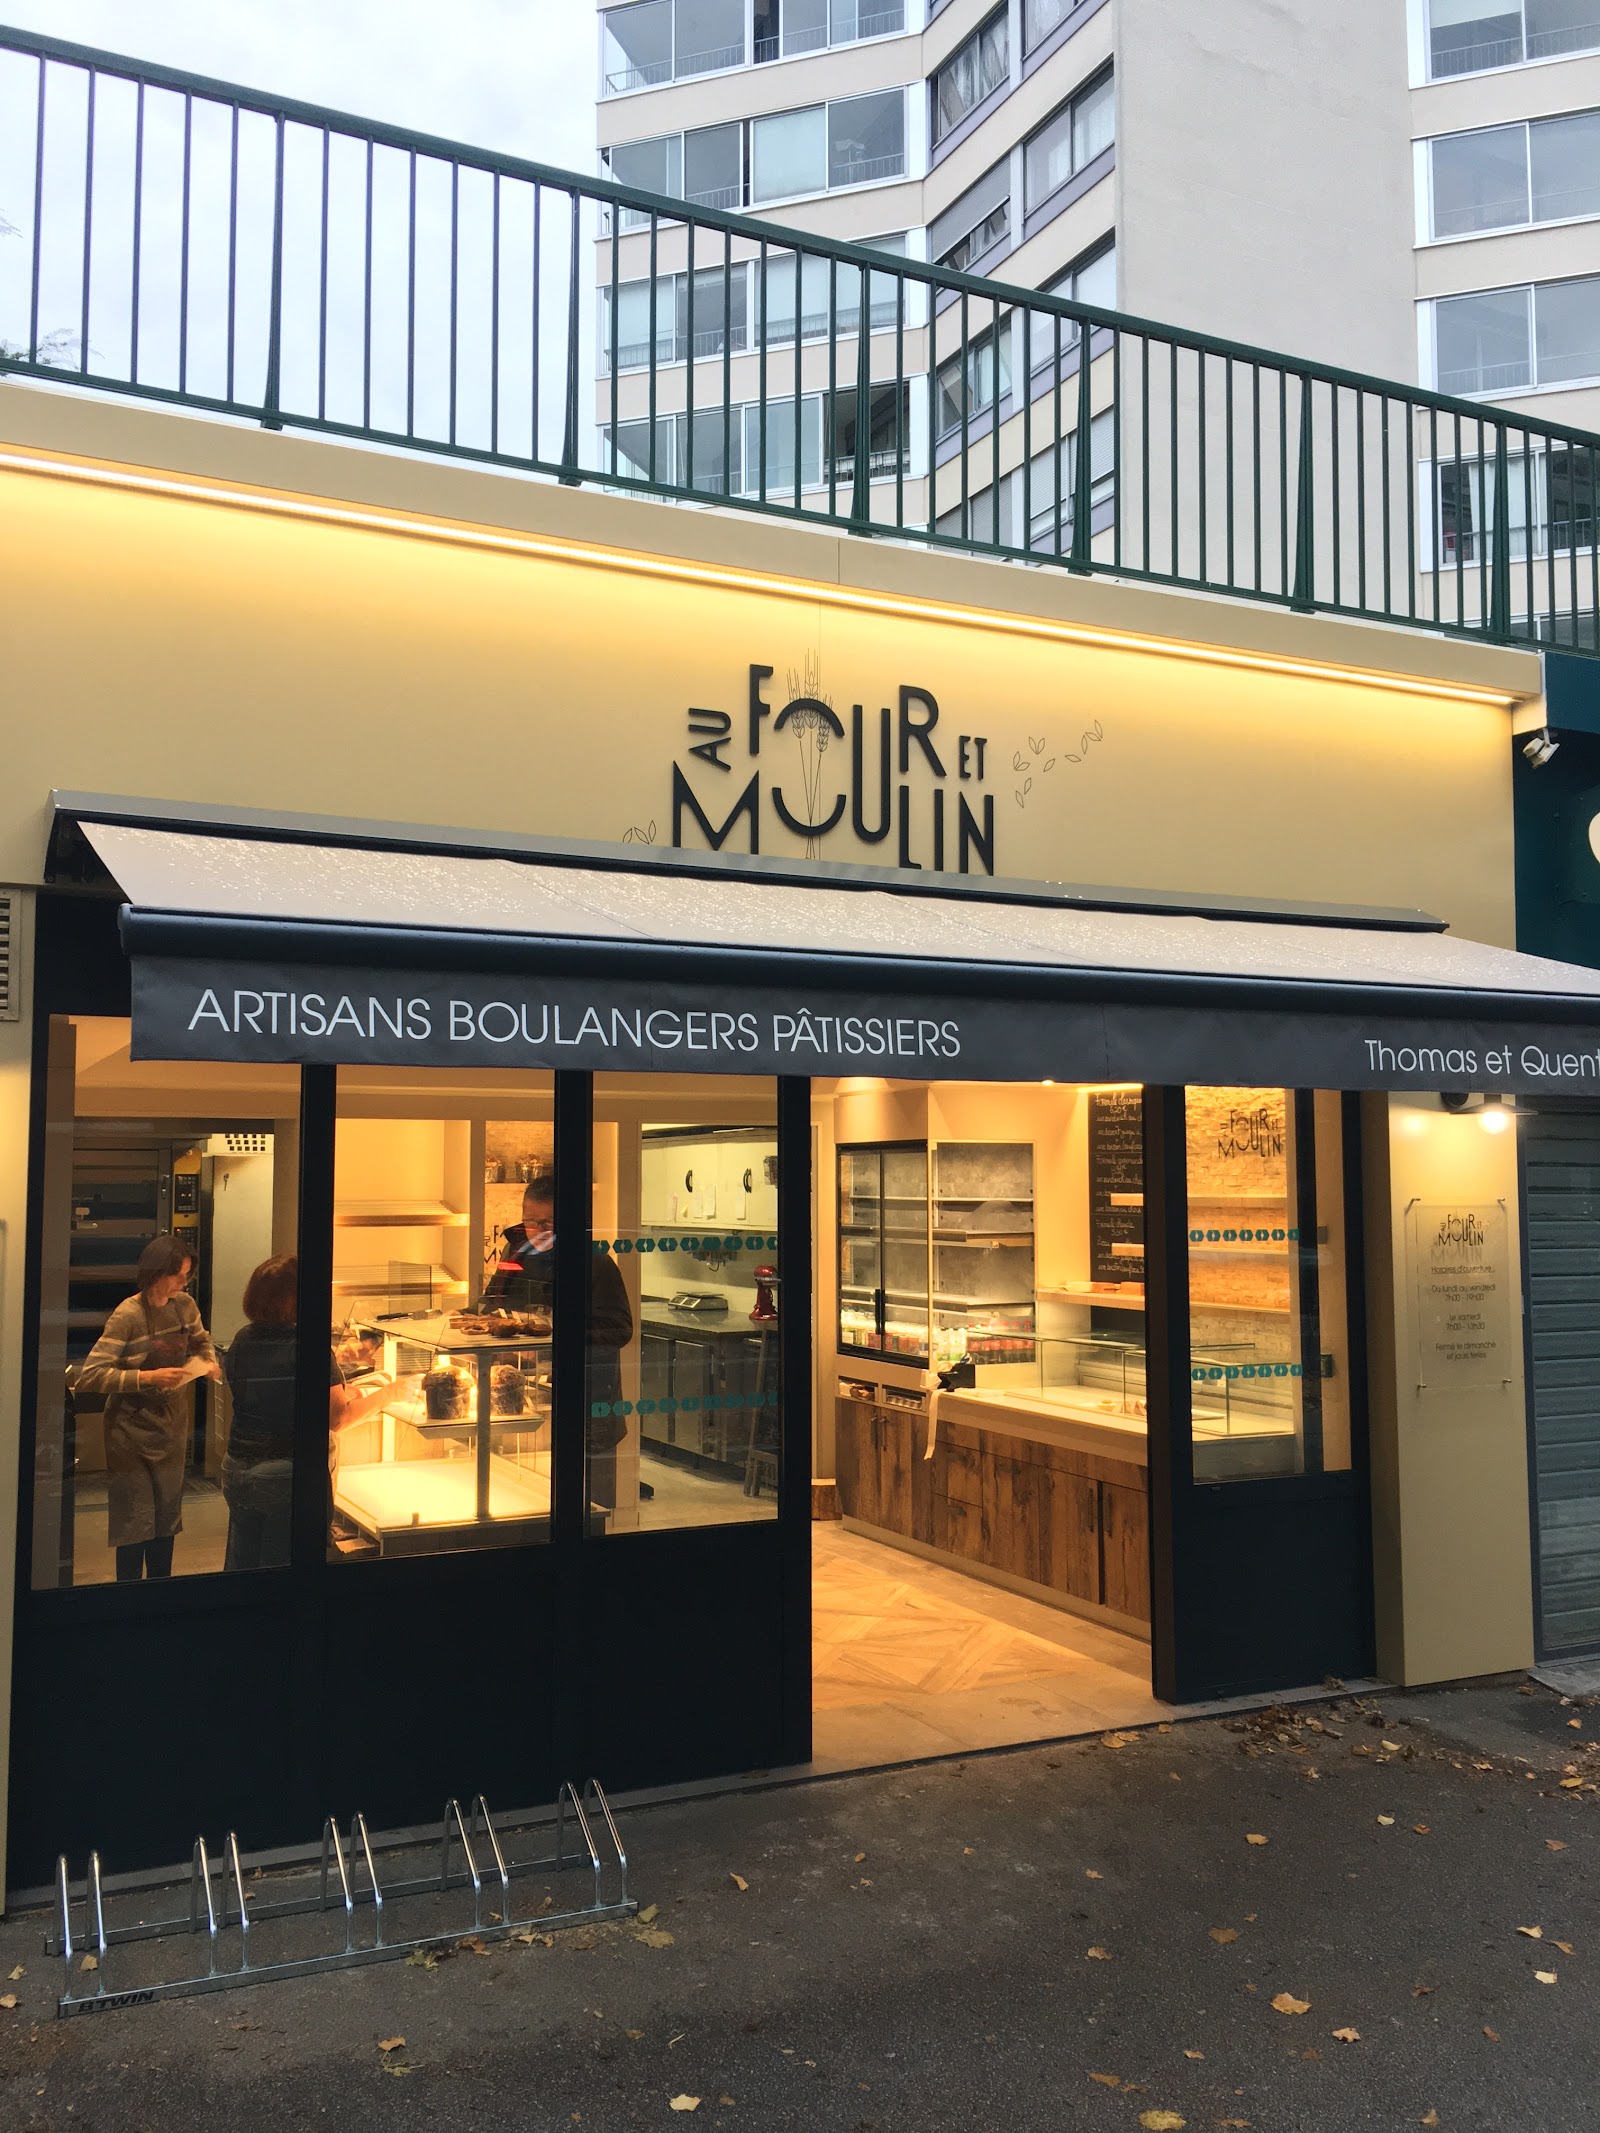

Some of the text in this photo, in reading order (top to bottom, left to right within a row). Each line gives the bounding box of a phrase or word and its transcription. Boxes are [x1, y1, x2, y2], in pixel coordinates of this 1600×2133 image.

[688, 664, 988, 843] AU FOUR ET
[672, 705, 994, 876] MOULIN
[188, 988, 961, 1058] ARTISANS BOULANGERS PÂTISSIERS
[1364, 1039, 1478, 1074] Thomas
[1485, 1043, 1513, 1075] et
[1217, 1116, 1281, 1159] MOULIN
[1438, 1218, 1484, 1247] MOULIN
[1447, 1213, 1476, 1242] FOUR
